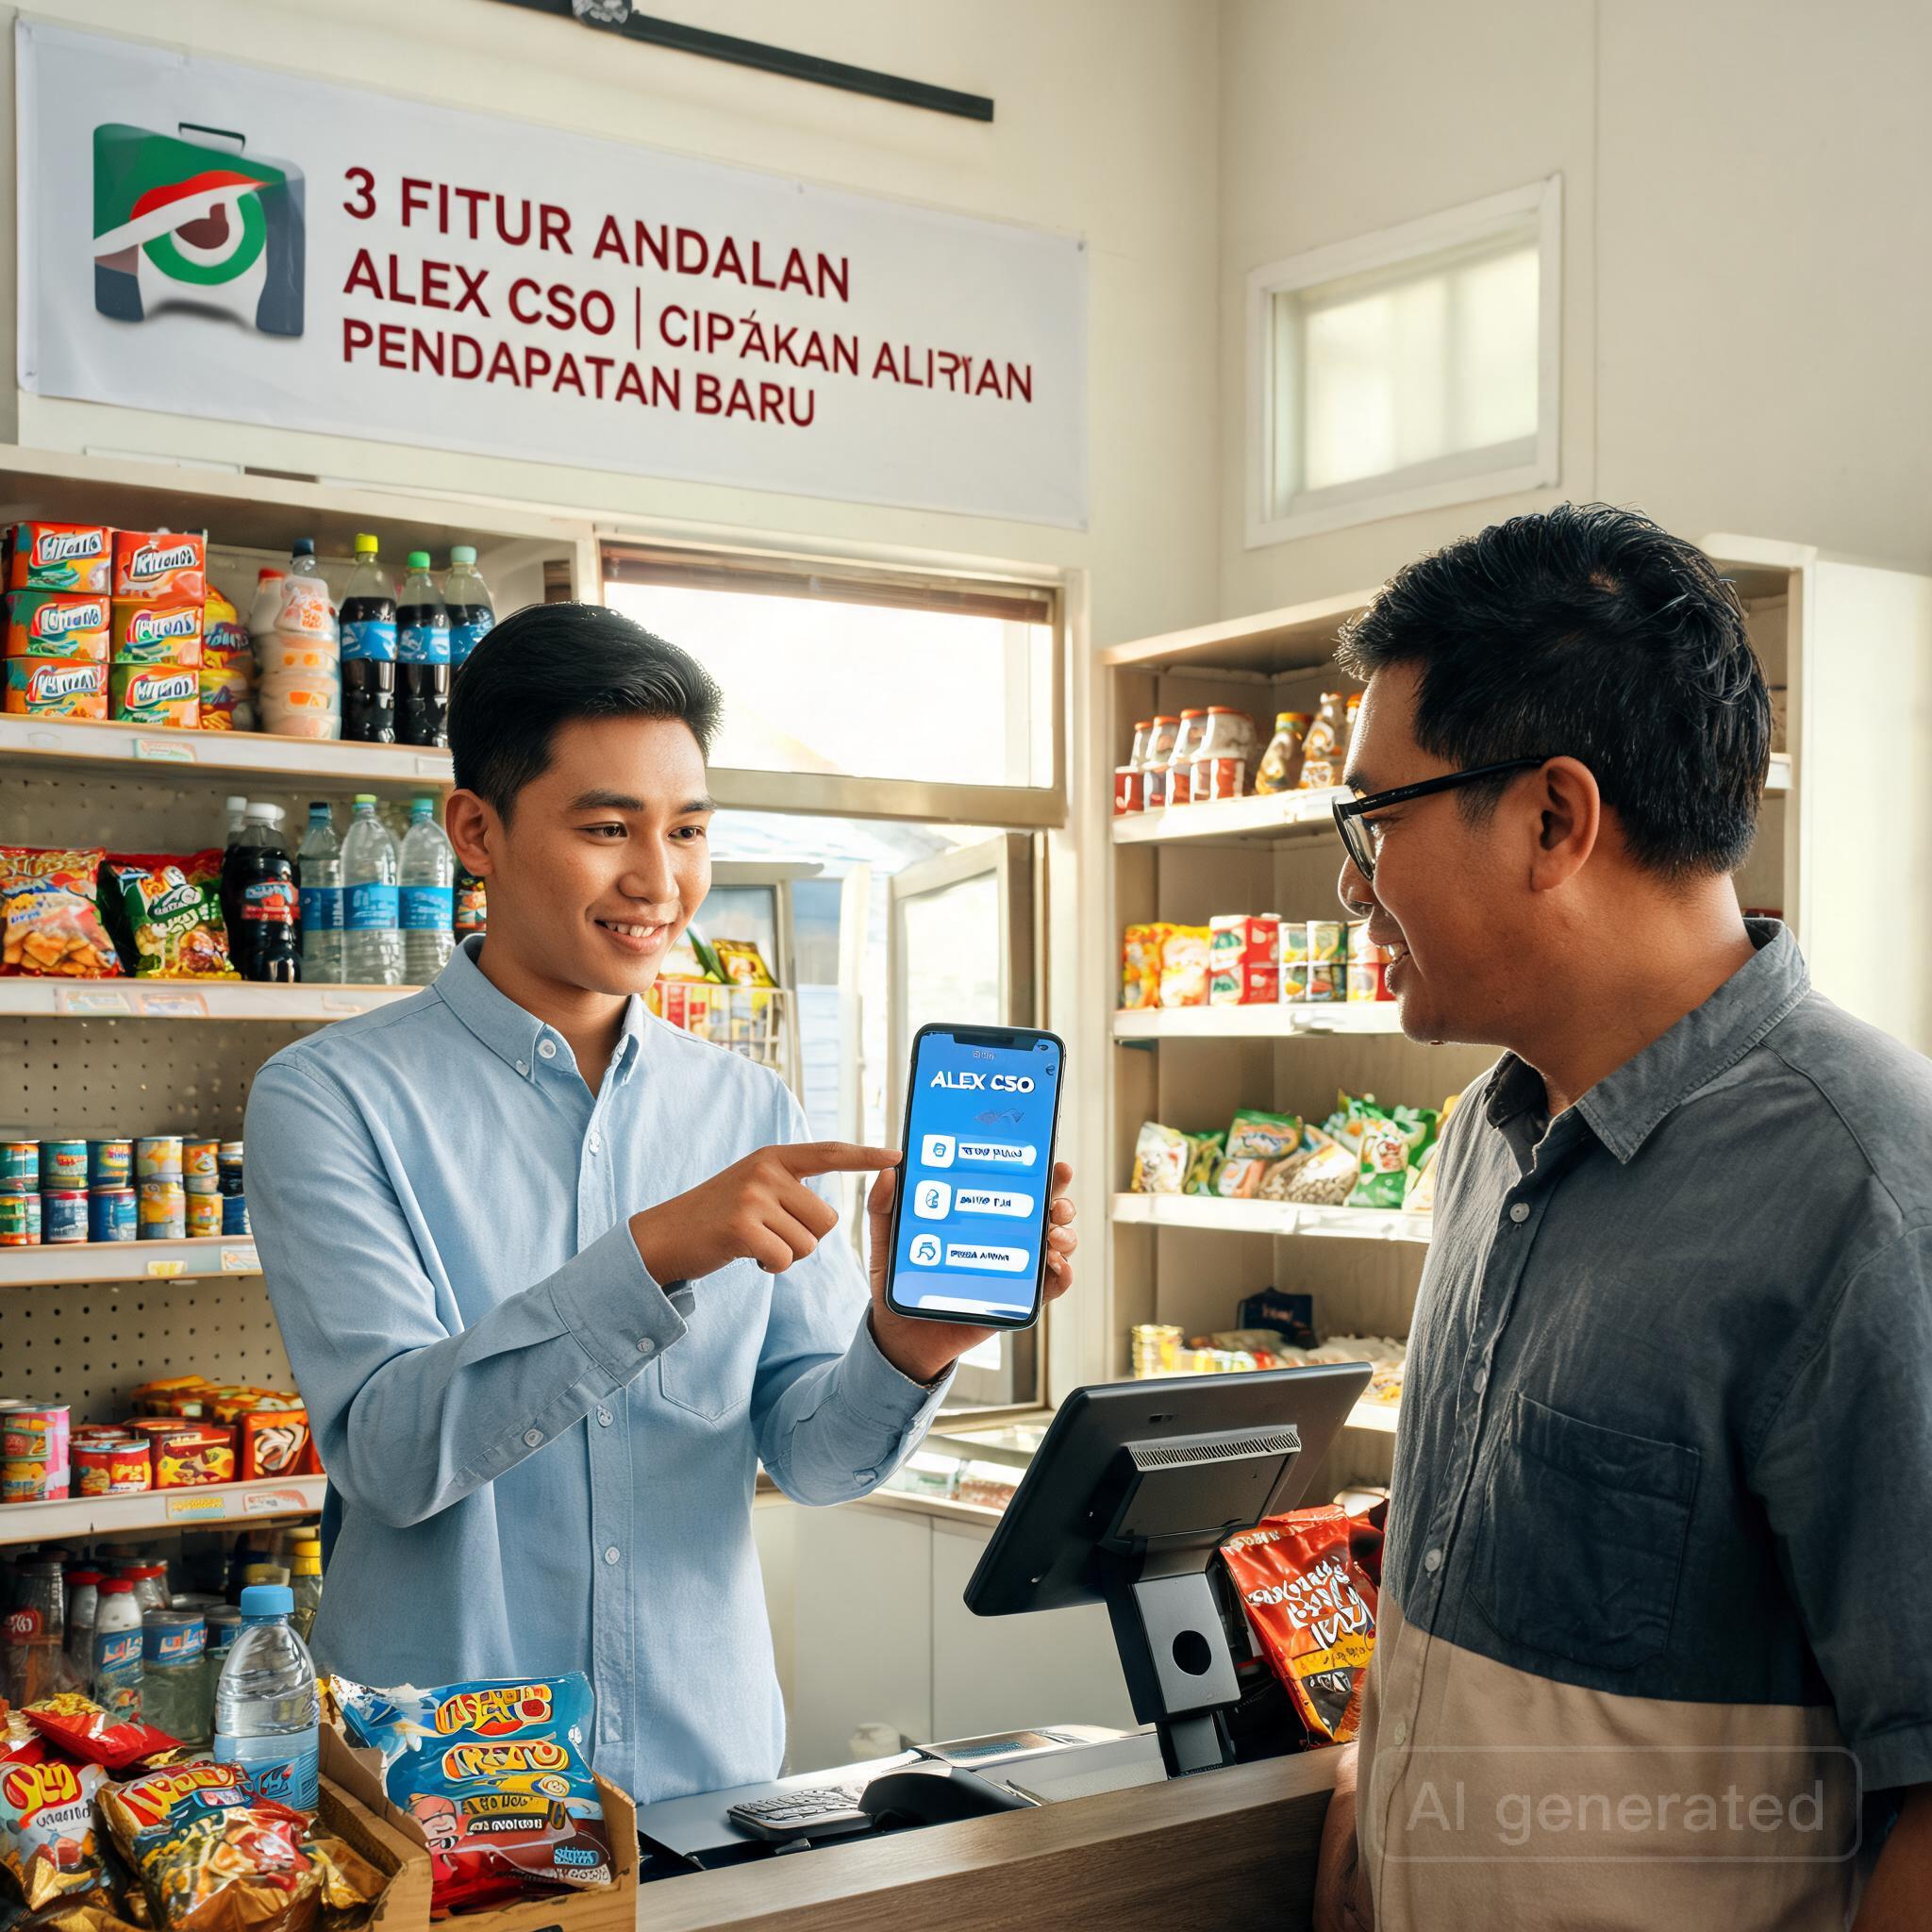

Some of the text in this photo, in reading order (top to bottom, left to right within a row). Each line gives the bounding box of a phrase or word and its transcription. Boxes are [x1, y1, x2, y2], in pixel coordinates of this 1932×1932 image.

[343, 167, 849, 303] 3 FITUR ANDALAN
[343, 249, 491, 318] ALEX
[508, 277, 616, 336] CSO
[343, 318, 815, 429] PENDAPATAN BARU
[930, 1070, 1035, 1093] ALEX CSO
